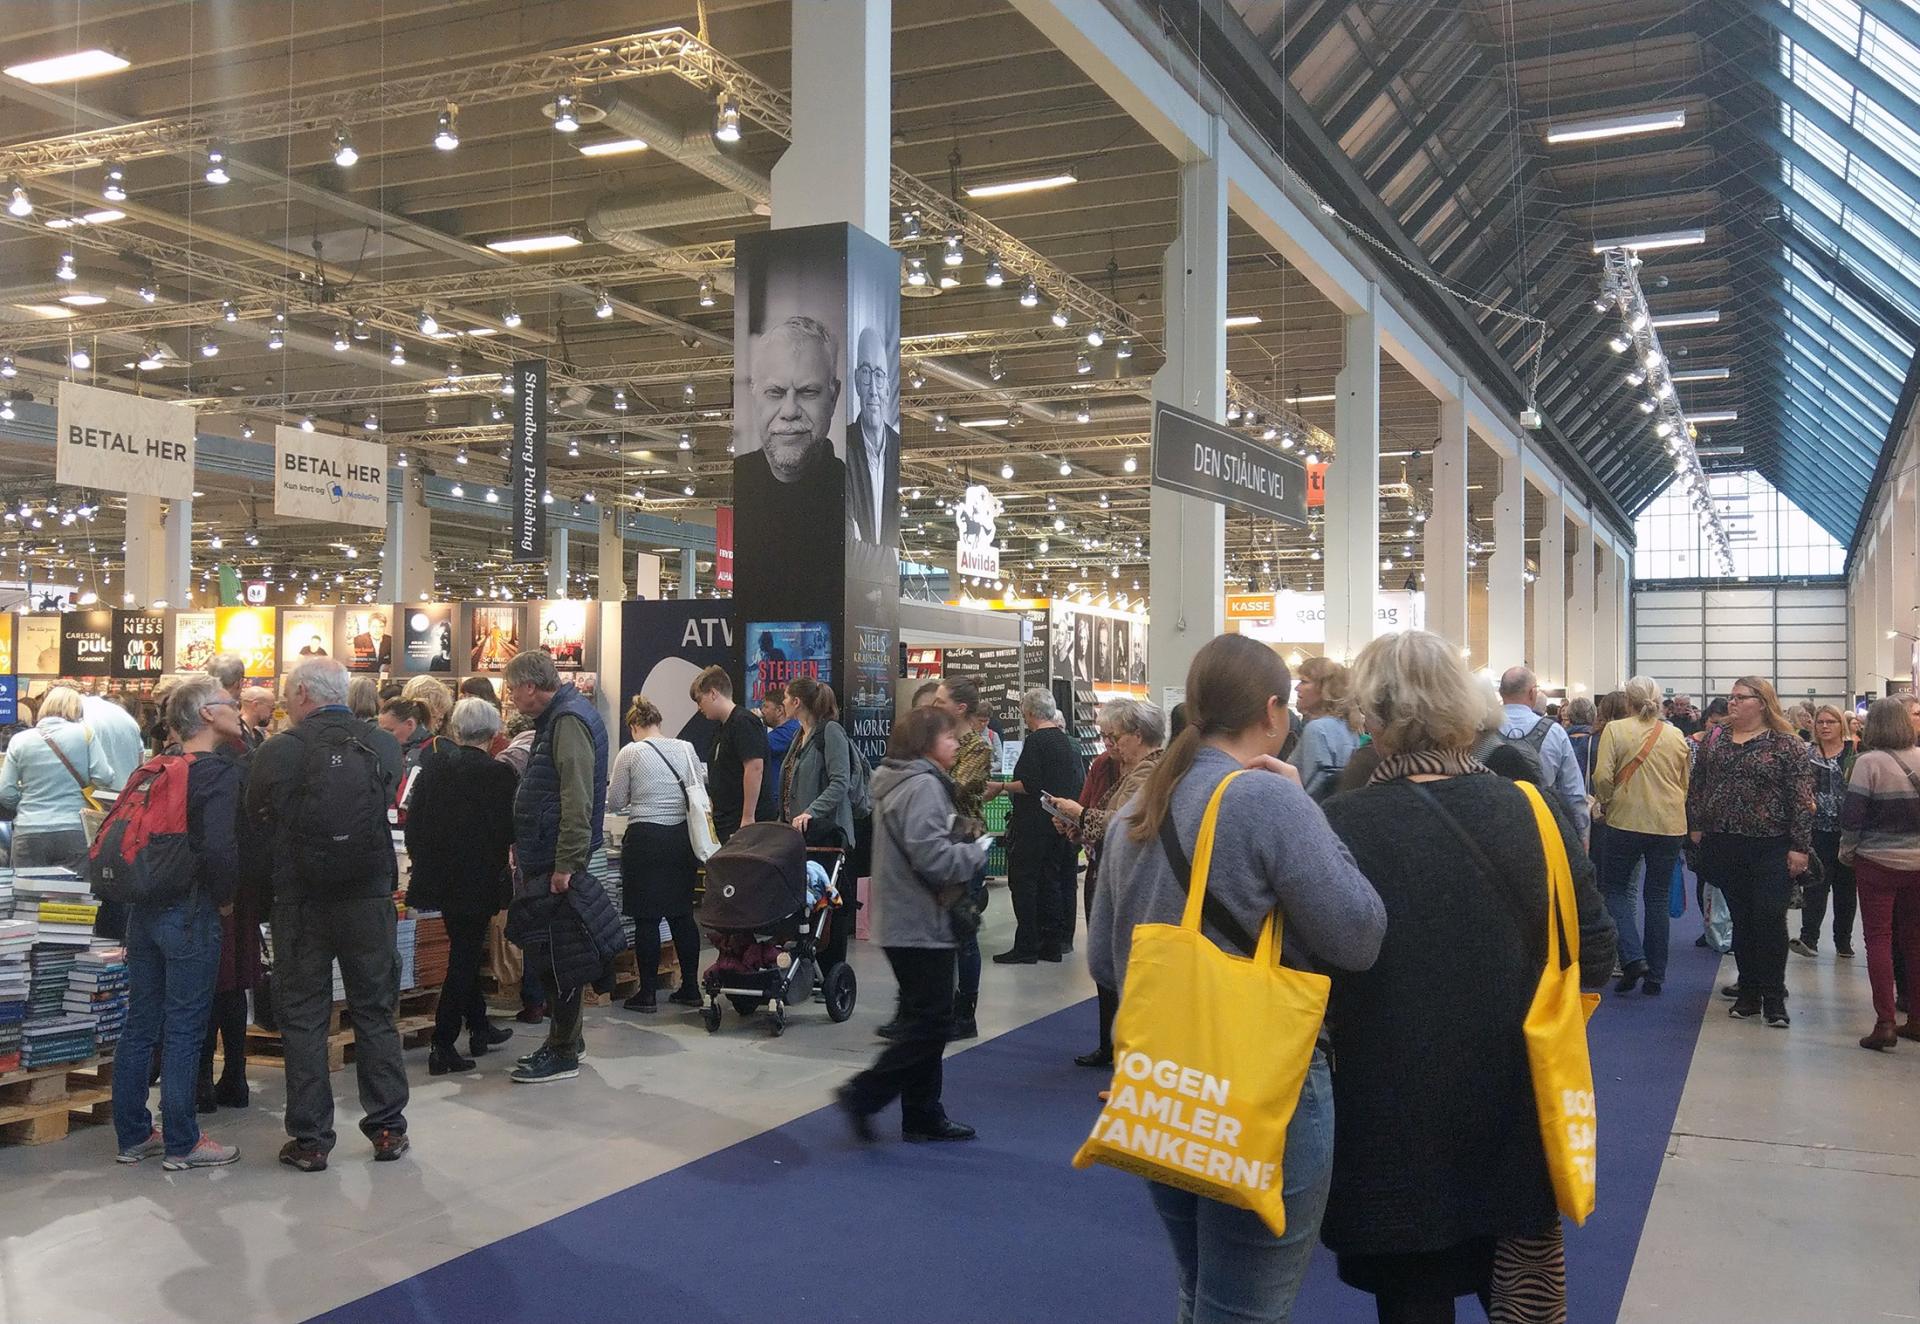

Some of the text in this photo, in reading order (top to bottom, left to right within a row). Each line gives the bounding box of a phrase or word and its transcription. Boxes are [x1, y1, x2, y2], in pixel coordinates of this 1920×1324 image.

[69, 424, 187, 462] BETAL HER
[285, 453, 381, 484] BETAL HER
[521, 371, 538, 551] Strandberg Publishing
[1194, 442, 1284, 500] DEN STJÅLNE VEJ
[283, 481, 325, 495] Kun kort og
[960, 551, 996, 573] Alvilda
[1231, 601, 1271, 611] KASSE
[65, 632, 101, 640] CARLSEN
[123, 623, 163, 634] NESS
[127, 639, 159, 656] CHAOS
[859, 633, 887, 652] NIELS
[123, 654, 162, 672] WALKING
[757, 659, 818, 681] STEFFEN
[853, 719, 891, 738] MØRKE
[1116, 1050, 1231, 1107] OGEN
[1106, 1081, 1243, 1148] AMLER
